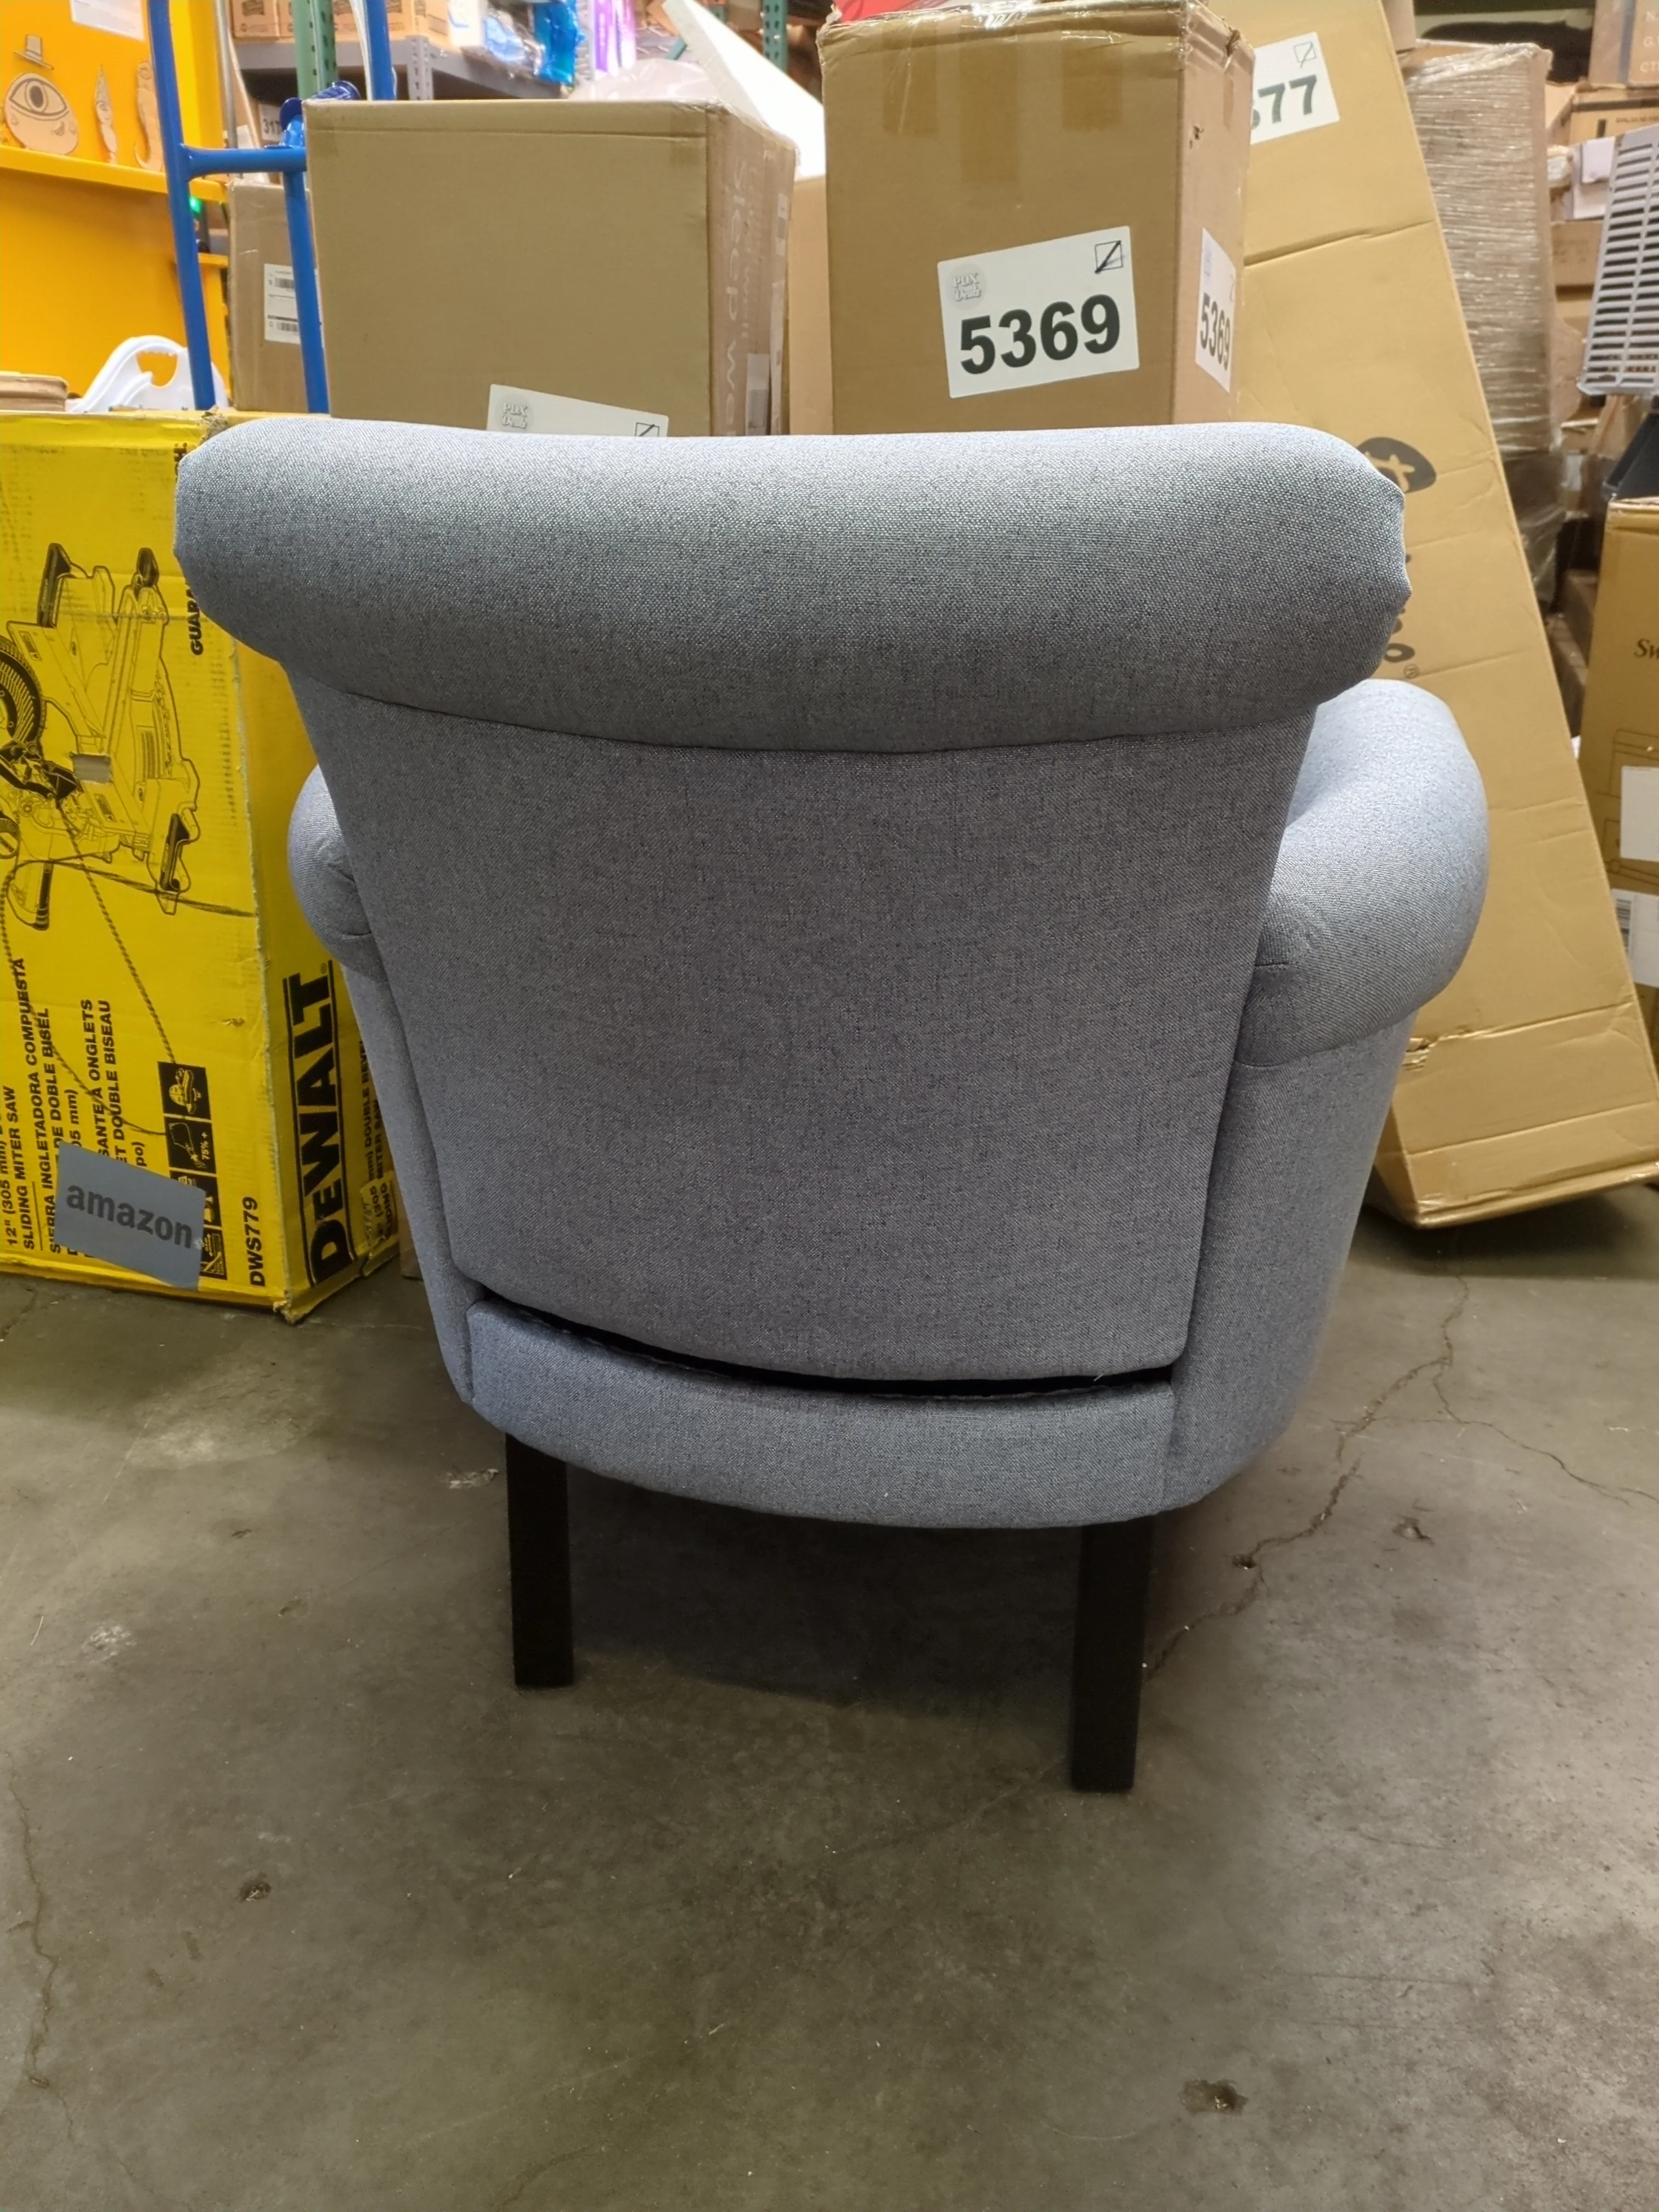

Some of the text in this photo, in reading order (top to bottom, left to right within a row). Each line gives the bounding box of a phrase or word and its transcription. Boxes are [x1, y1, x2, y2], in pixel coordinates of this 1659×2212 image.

[1251, 74, 1317, 131] 77
[952, 272, 979, 288] PDX
[960, 294, 1120, 375] 5369
[1200, 292, 1231, 371] 5369
[504, 402, 528, 417] PDX
[13, 958, 37, 1066] COMPUESTA
[36, 1008, 54, 1058] BISEL
[80, 999, 101, 1081] ONGLETS
[98, 1000, 116, 1065] BISEAU
[43, 1063, 61, 1121] DOBLE
[64, 1089, 78, 1125] mm)
[106, 1070, 125, 1141] DOUBLE
[362, 1087, 373, 1148] DOUBLE
[27, 1071, 53, 1189] INGLETADORA
[200, 1141, 211, 1160] 75%
[288, 972, 354, 1283] DEWALT
[1, 1179, 16, 1215] (305
[3, 1085, 35, 1250] SLIDING MITER SAW
[65, 1184, 193, 1250] amazon
[242, 1197, 266, 1287] DWS779
